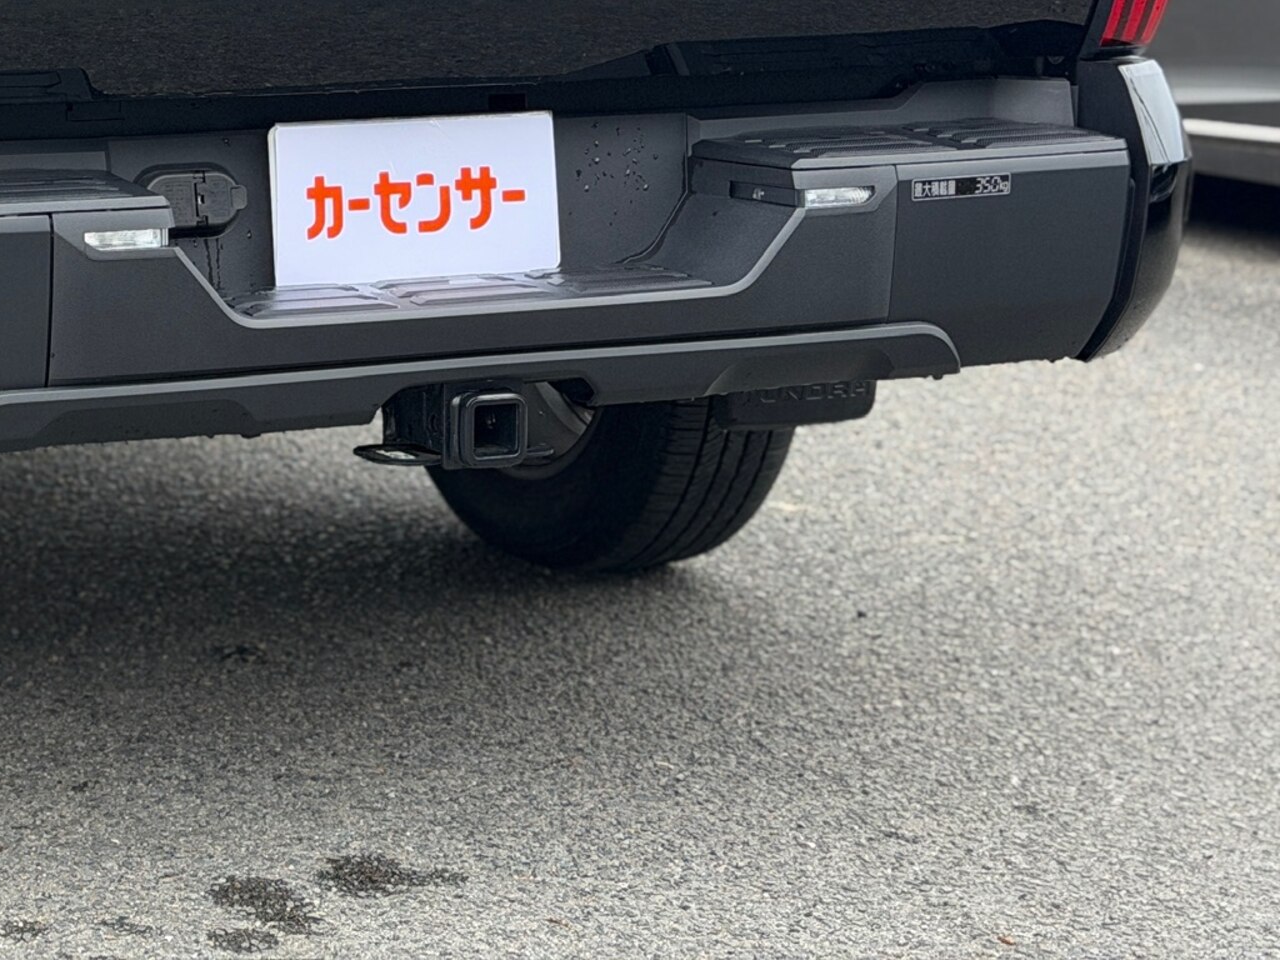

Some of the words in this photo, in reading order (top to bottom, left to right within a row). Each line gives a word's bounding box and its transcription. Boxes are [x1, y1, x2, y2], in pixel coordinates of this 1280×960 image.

[305, 165, 527, 240] カーセンサー
